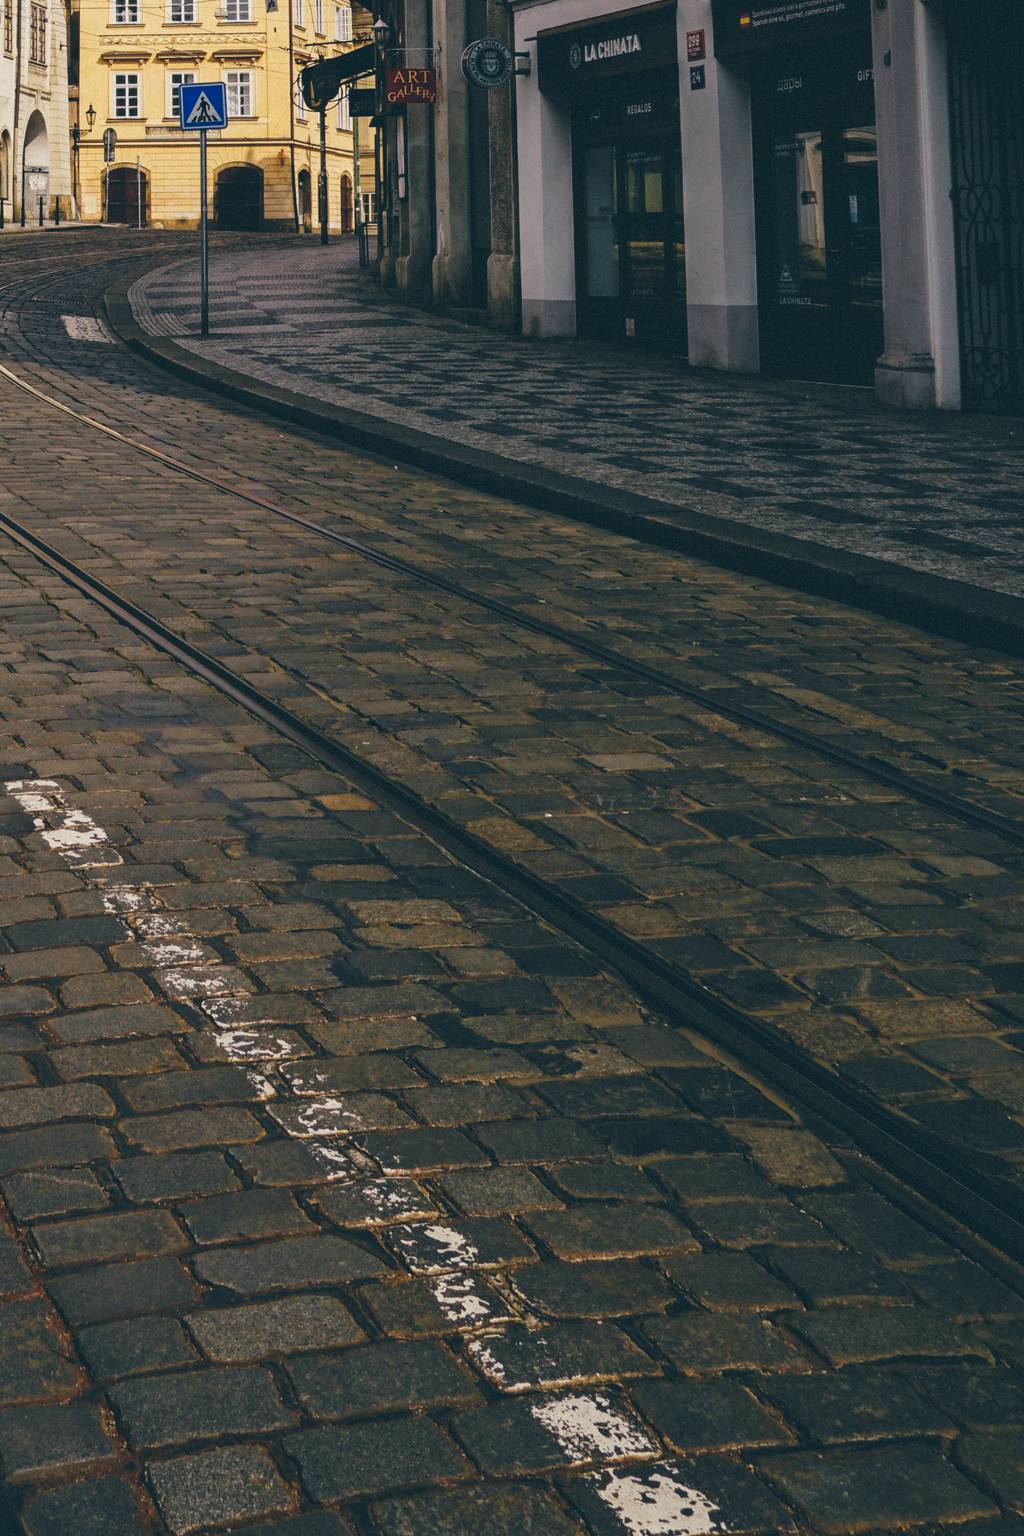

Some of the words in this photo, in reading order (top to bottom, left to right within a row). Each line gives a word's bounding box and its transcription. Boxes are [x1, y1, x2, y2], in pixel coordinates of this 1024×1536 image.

[584, 44, 598, 62] LA
[598, 33, 642, 59] CHINATA
[688, 34, 700, 48] 299
[393, 70, 431, 83] ART
[691, 71, 701, 84] 24
[387, 84, 436, 103] GALLERY
[627, 102, 653, 115] REGALOS
